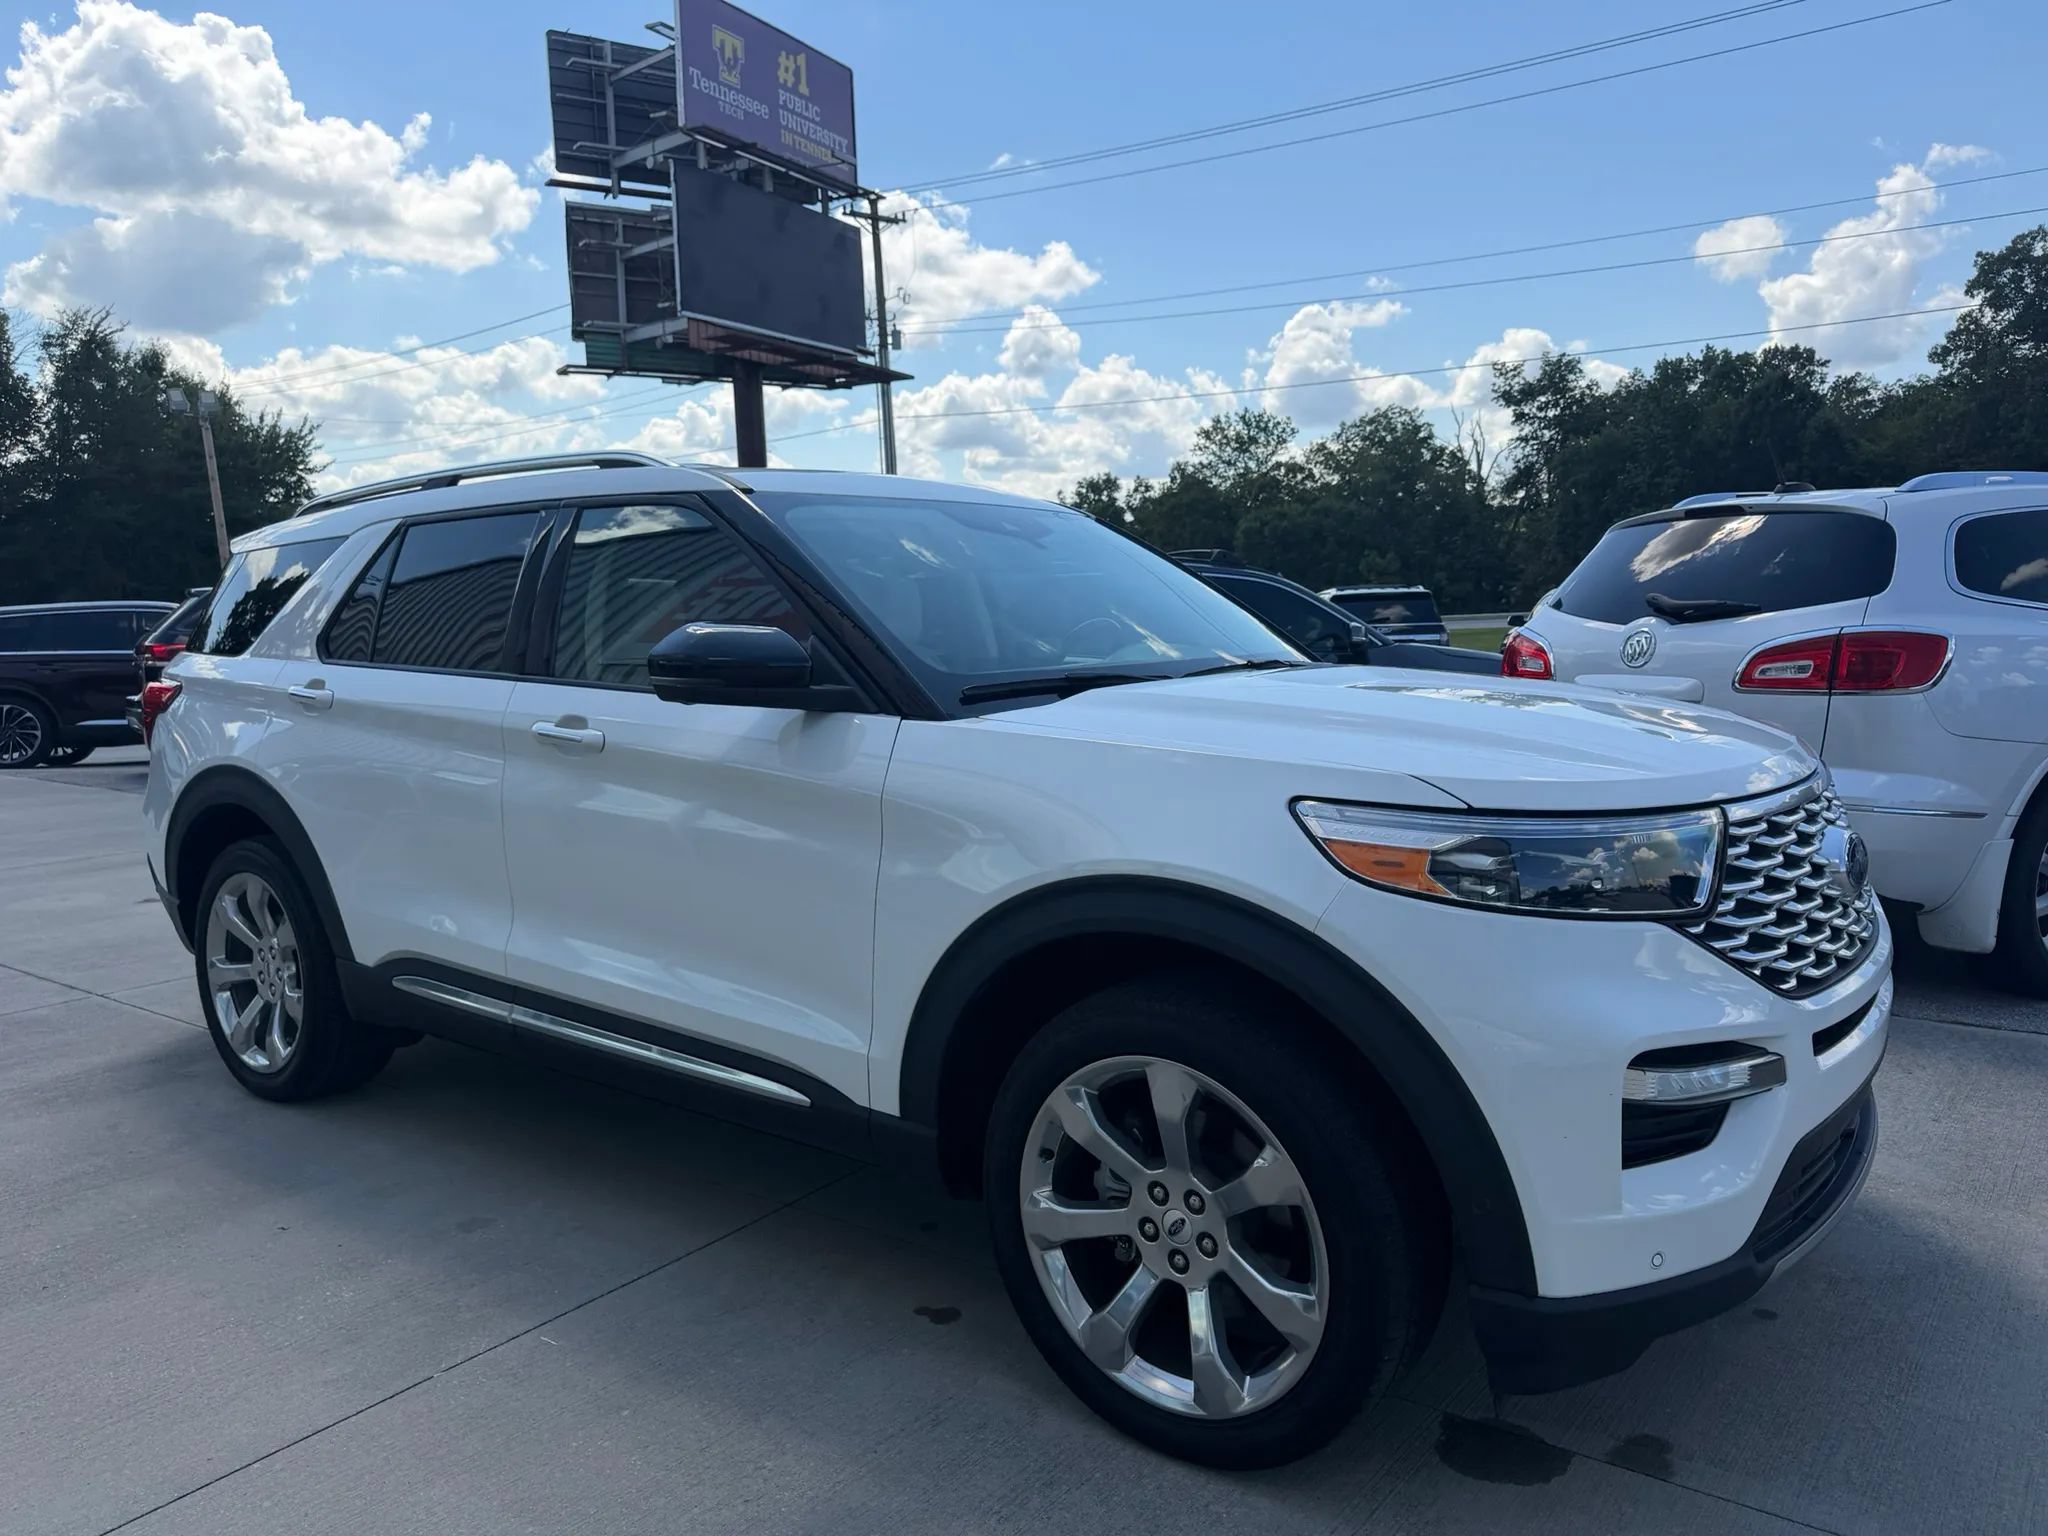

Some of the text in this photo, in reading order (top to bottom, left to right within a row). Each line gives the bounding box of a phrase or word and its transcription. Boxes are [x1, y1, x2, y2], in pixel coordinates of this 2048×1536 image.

[689, 66, 769, 119] Tennessee
[777, 50, 810, 96] #1
[718, 101, 745, 121] TECH
[778, 88, 821, 122] PUBLIC
[779, 108, 849, 153] UNIVERSITY
[780, 128, 794, 147] IN
